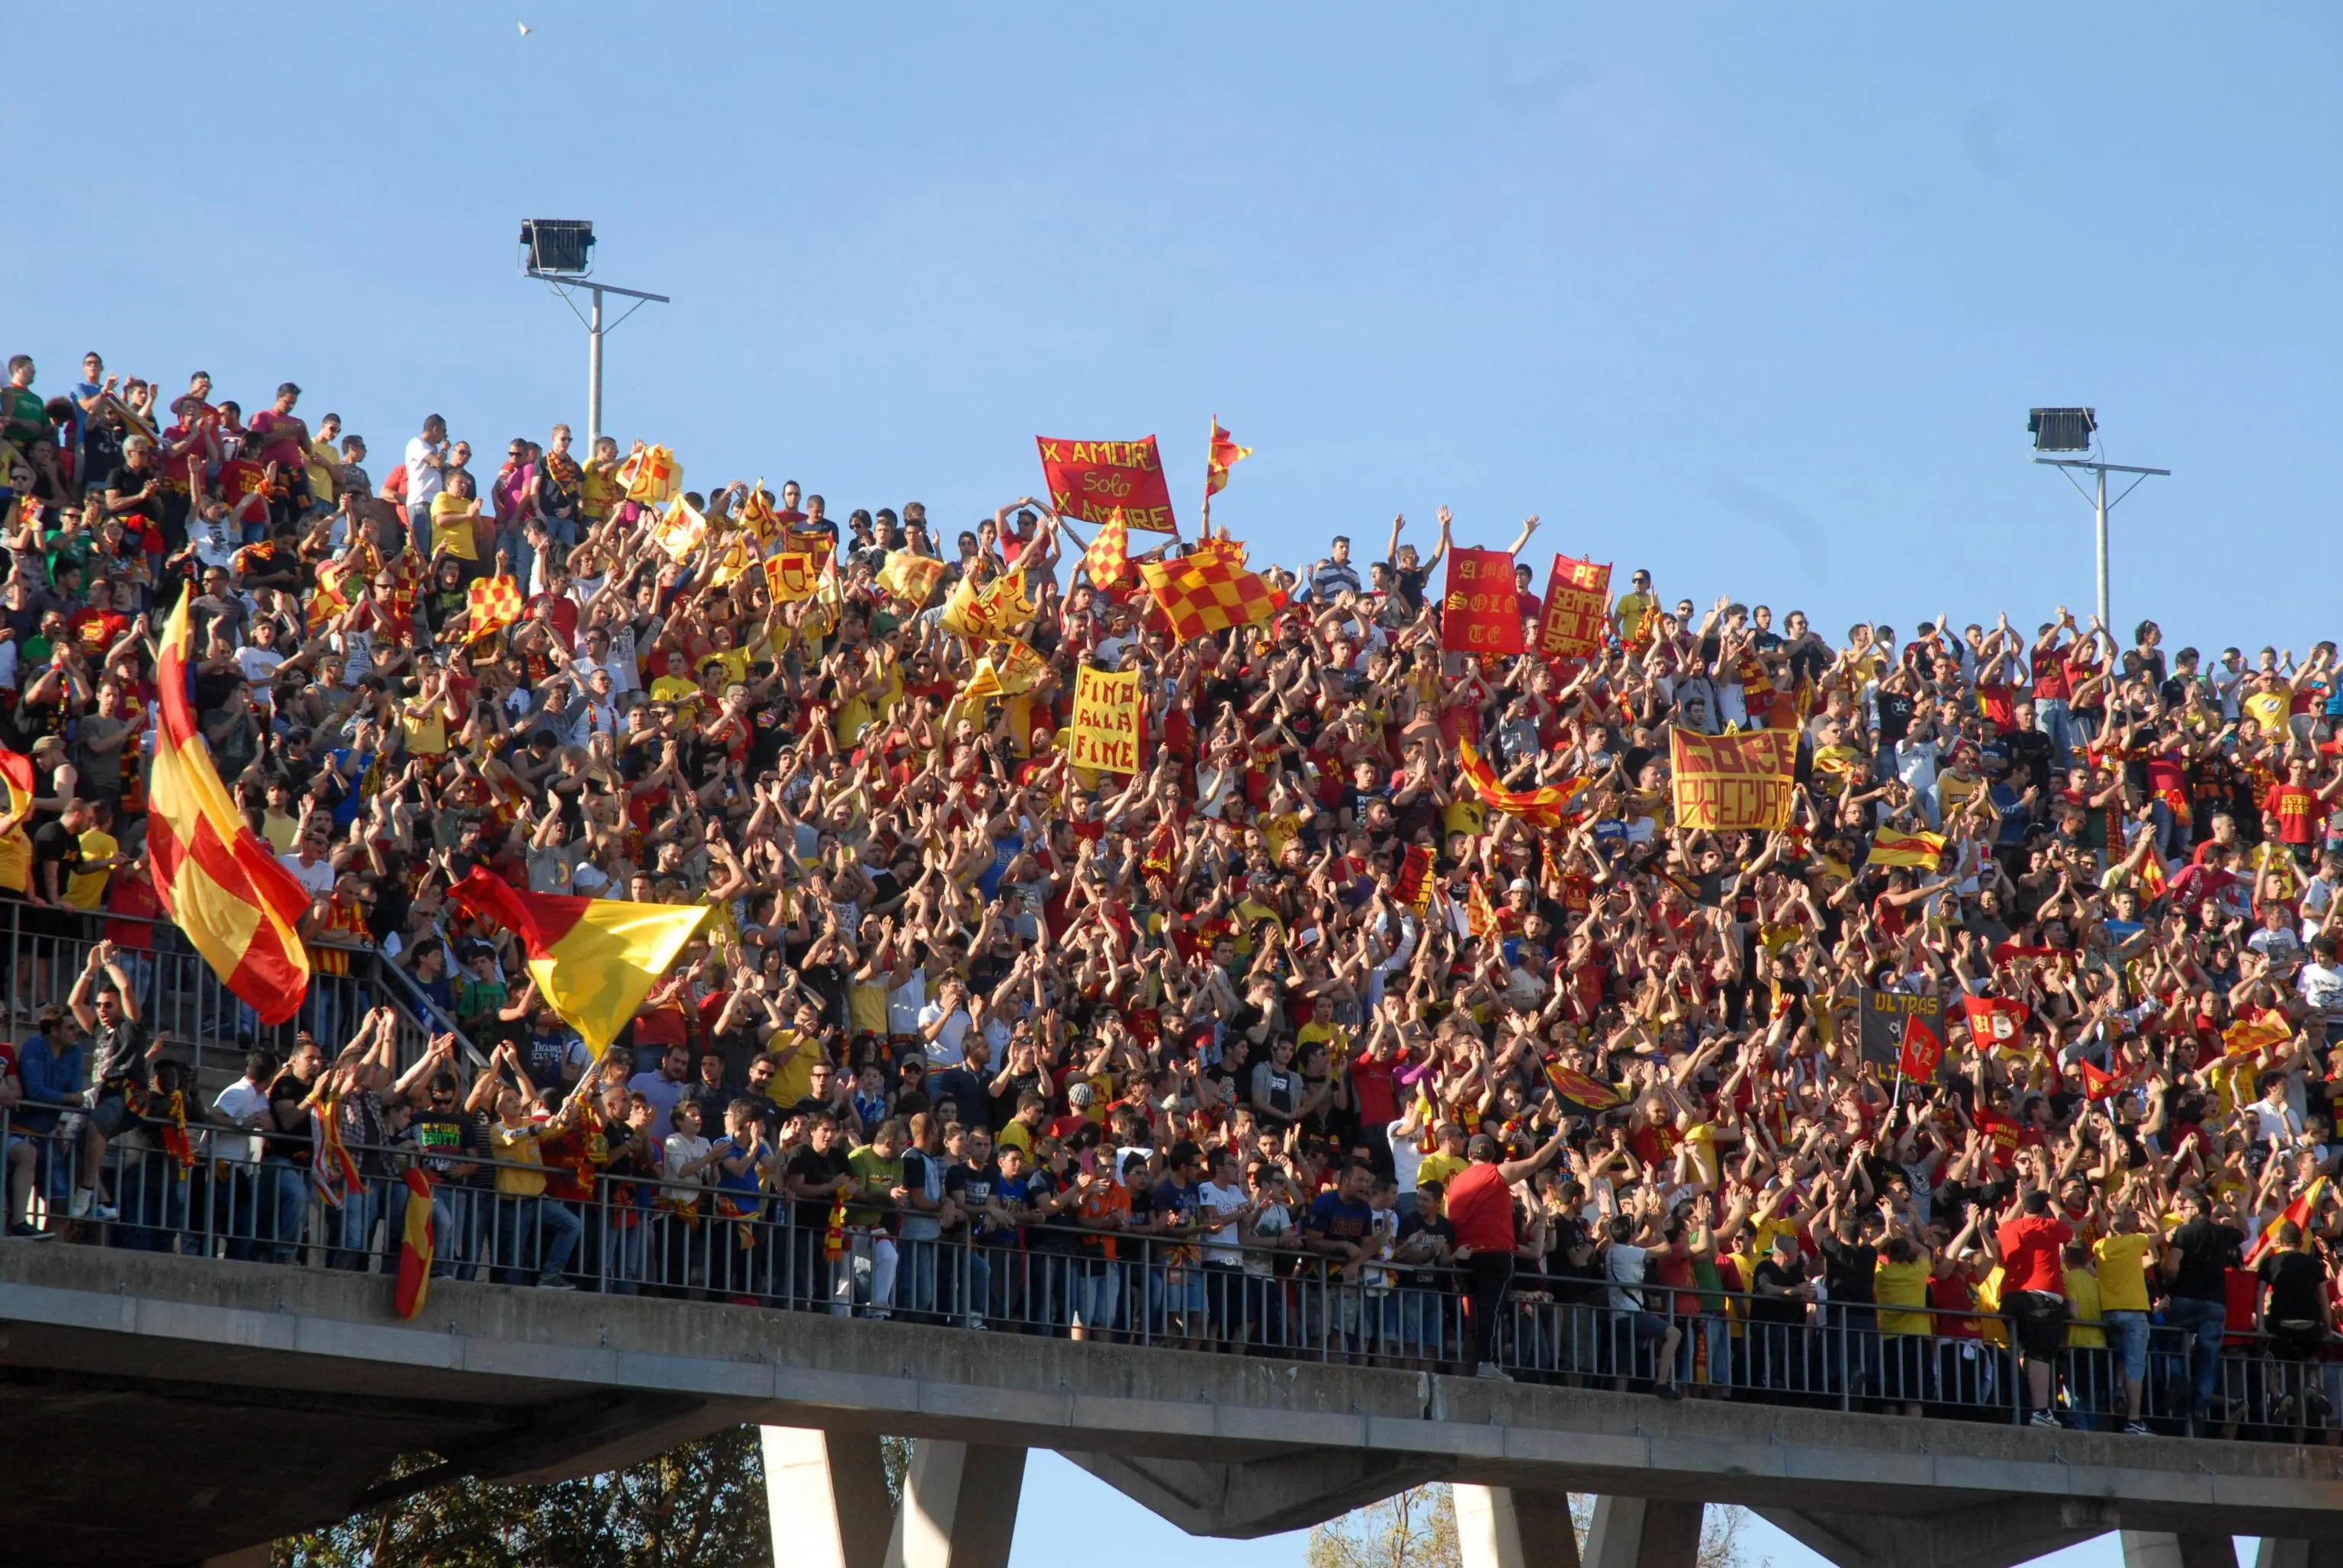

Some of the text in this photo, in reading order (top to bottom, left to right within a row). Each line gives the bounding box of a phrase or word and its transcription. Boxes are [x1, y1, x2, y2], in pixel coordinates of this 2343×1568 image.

[1039, 442, 1062, 463] X
[1052, 491, 1073, 516] X
[1572, 564, 1609, 590] PER
[1468, 624, 1501, 644] TE
[1547, 608, 1580, 638] CON
[1079, 673, 1134, 707] FINO
[1078, 708, 1133, 734] ALLA
[1075, 734, 1134, 769] FINE
[1874, 993, 1938, 1014] ULTRAS
